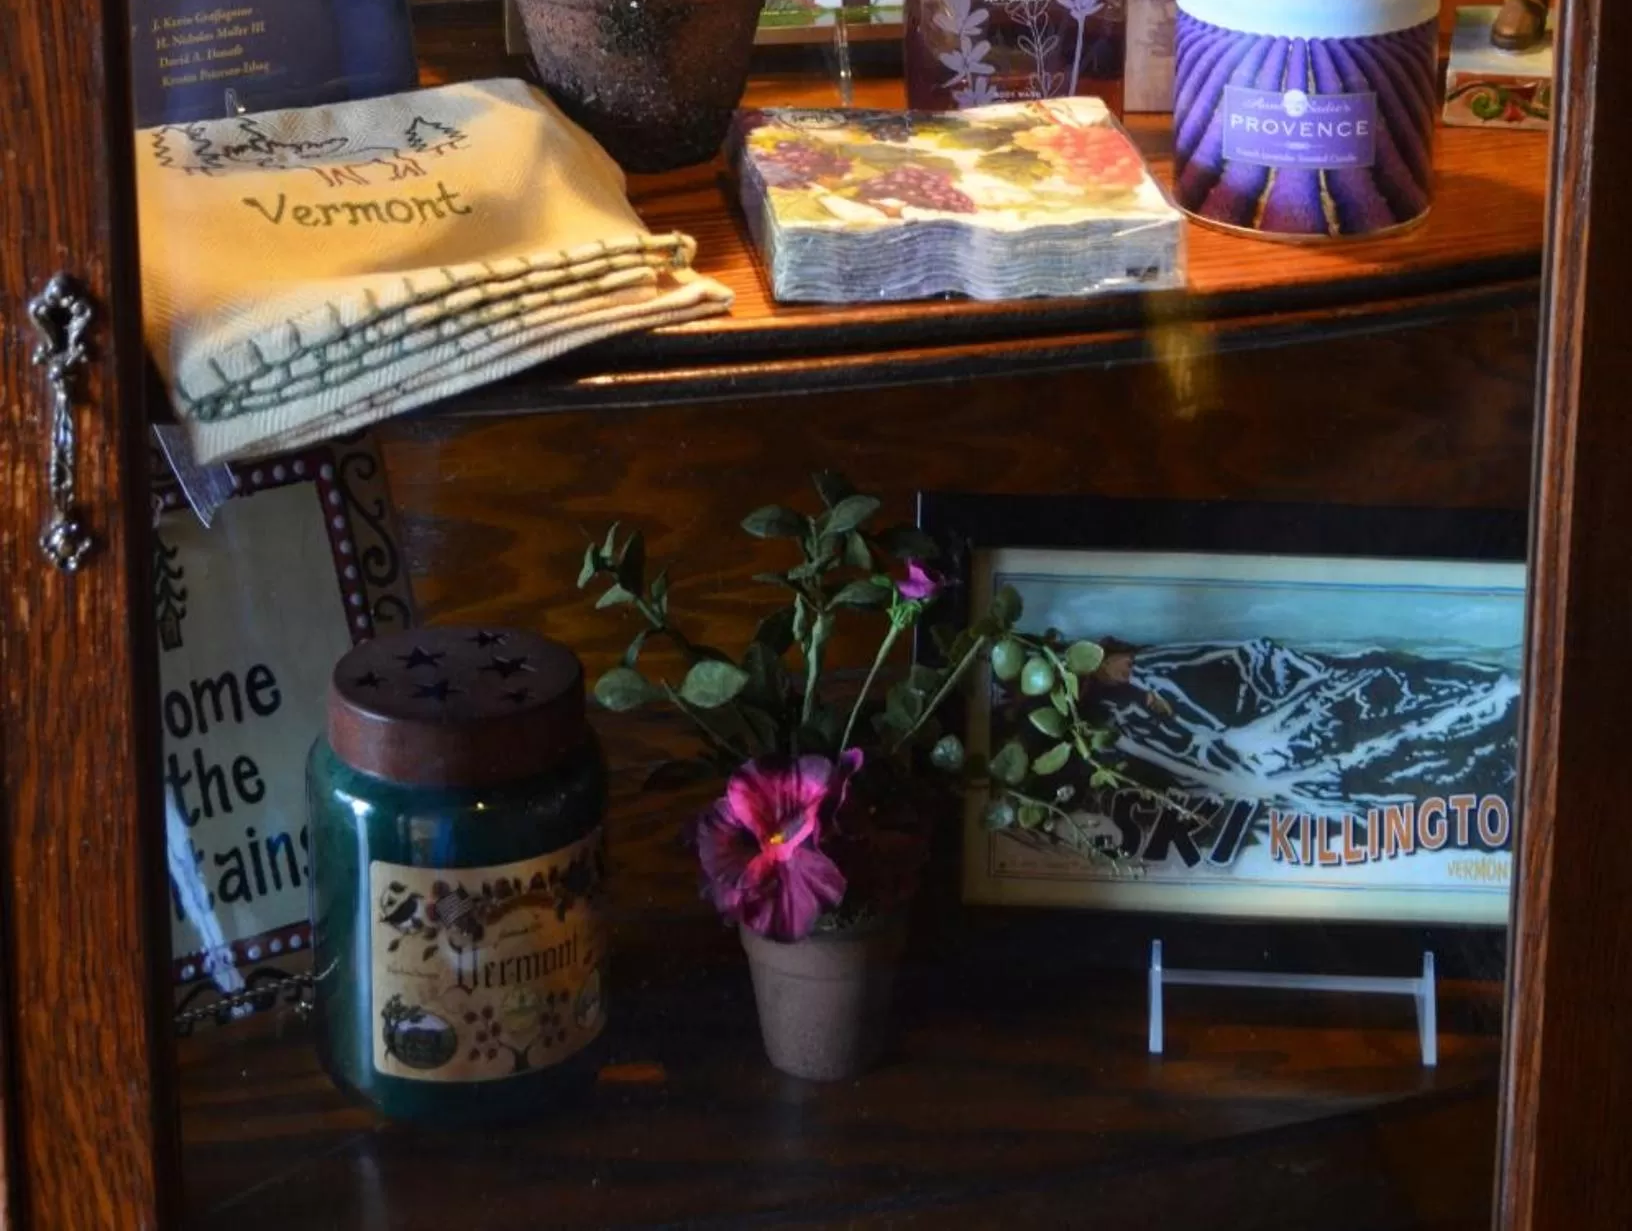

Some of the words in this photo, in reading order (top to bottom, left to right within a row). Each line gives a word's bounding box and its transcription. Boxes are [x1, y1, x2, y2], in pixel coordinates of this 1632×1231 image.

[1230, 113, 1369, 138] PROVENCE
[243, 181, 473, 227] Vermont
[162, 664, 281, 738] ome
[164, 747, 265, 827] the
[1111, 786, 1260, 869] SKI
[1268, 793, 1511, 867] KILLINGTO
[1447, 858, 1509, 881] VERMON
